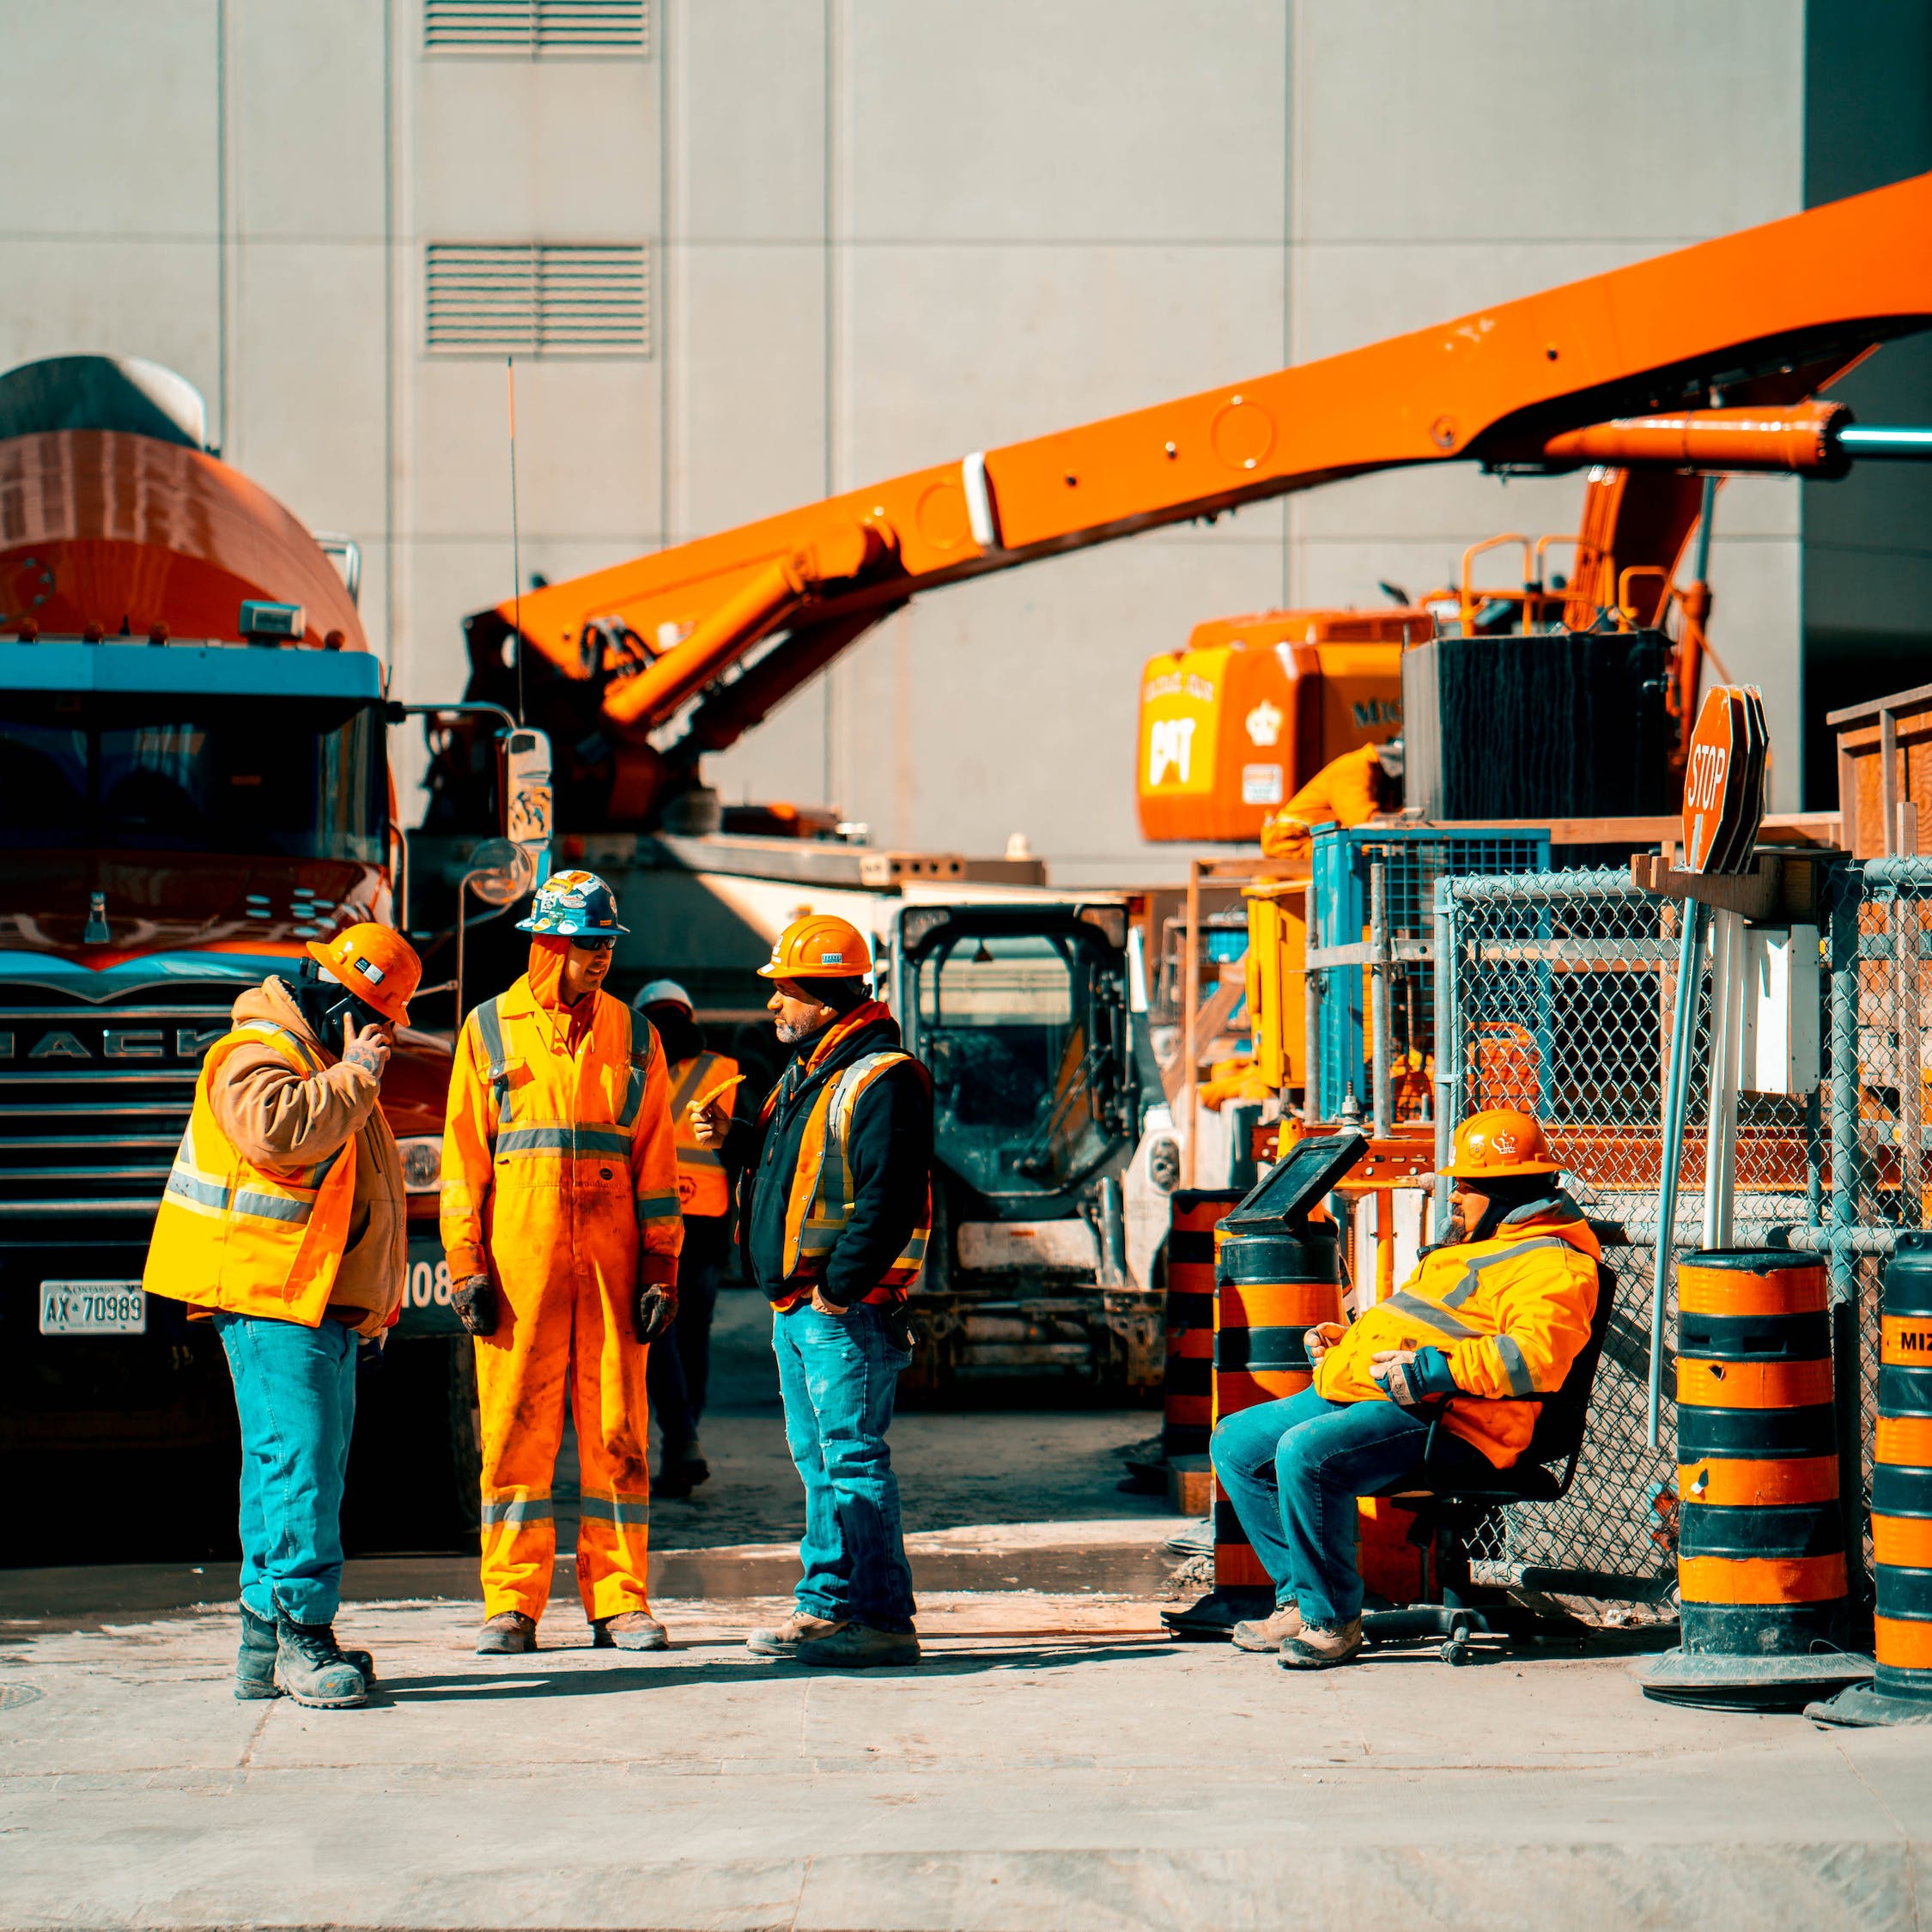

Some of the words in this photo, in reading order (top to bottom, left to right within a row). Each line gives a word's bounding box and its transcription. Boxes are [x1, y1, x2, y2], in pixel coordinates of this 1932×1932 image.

[1688, 744, 1726, 811] STOP
[0, 1030, 230, 1058] ACK
[46, 1293, 70, 1322] AX
[82, 1292, 143, 1322] 70989
